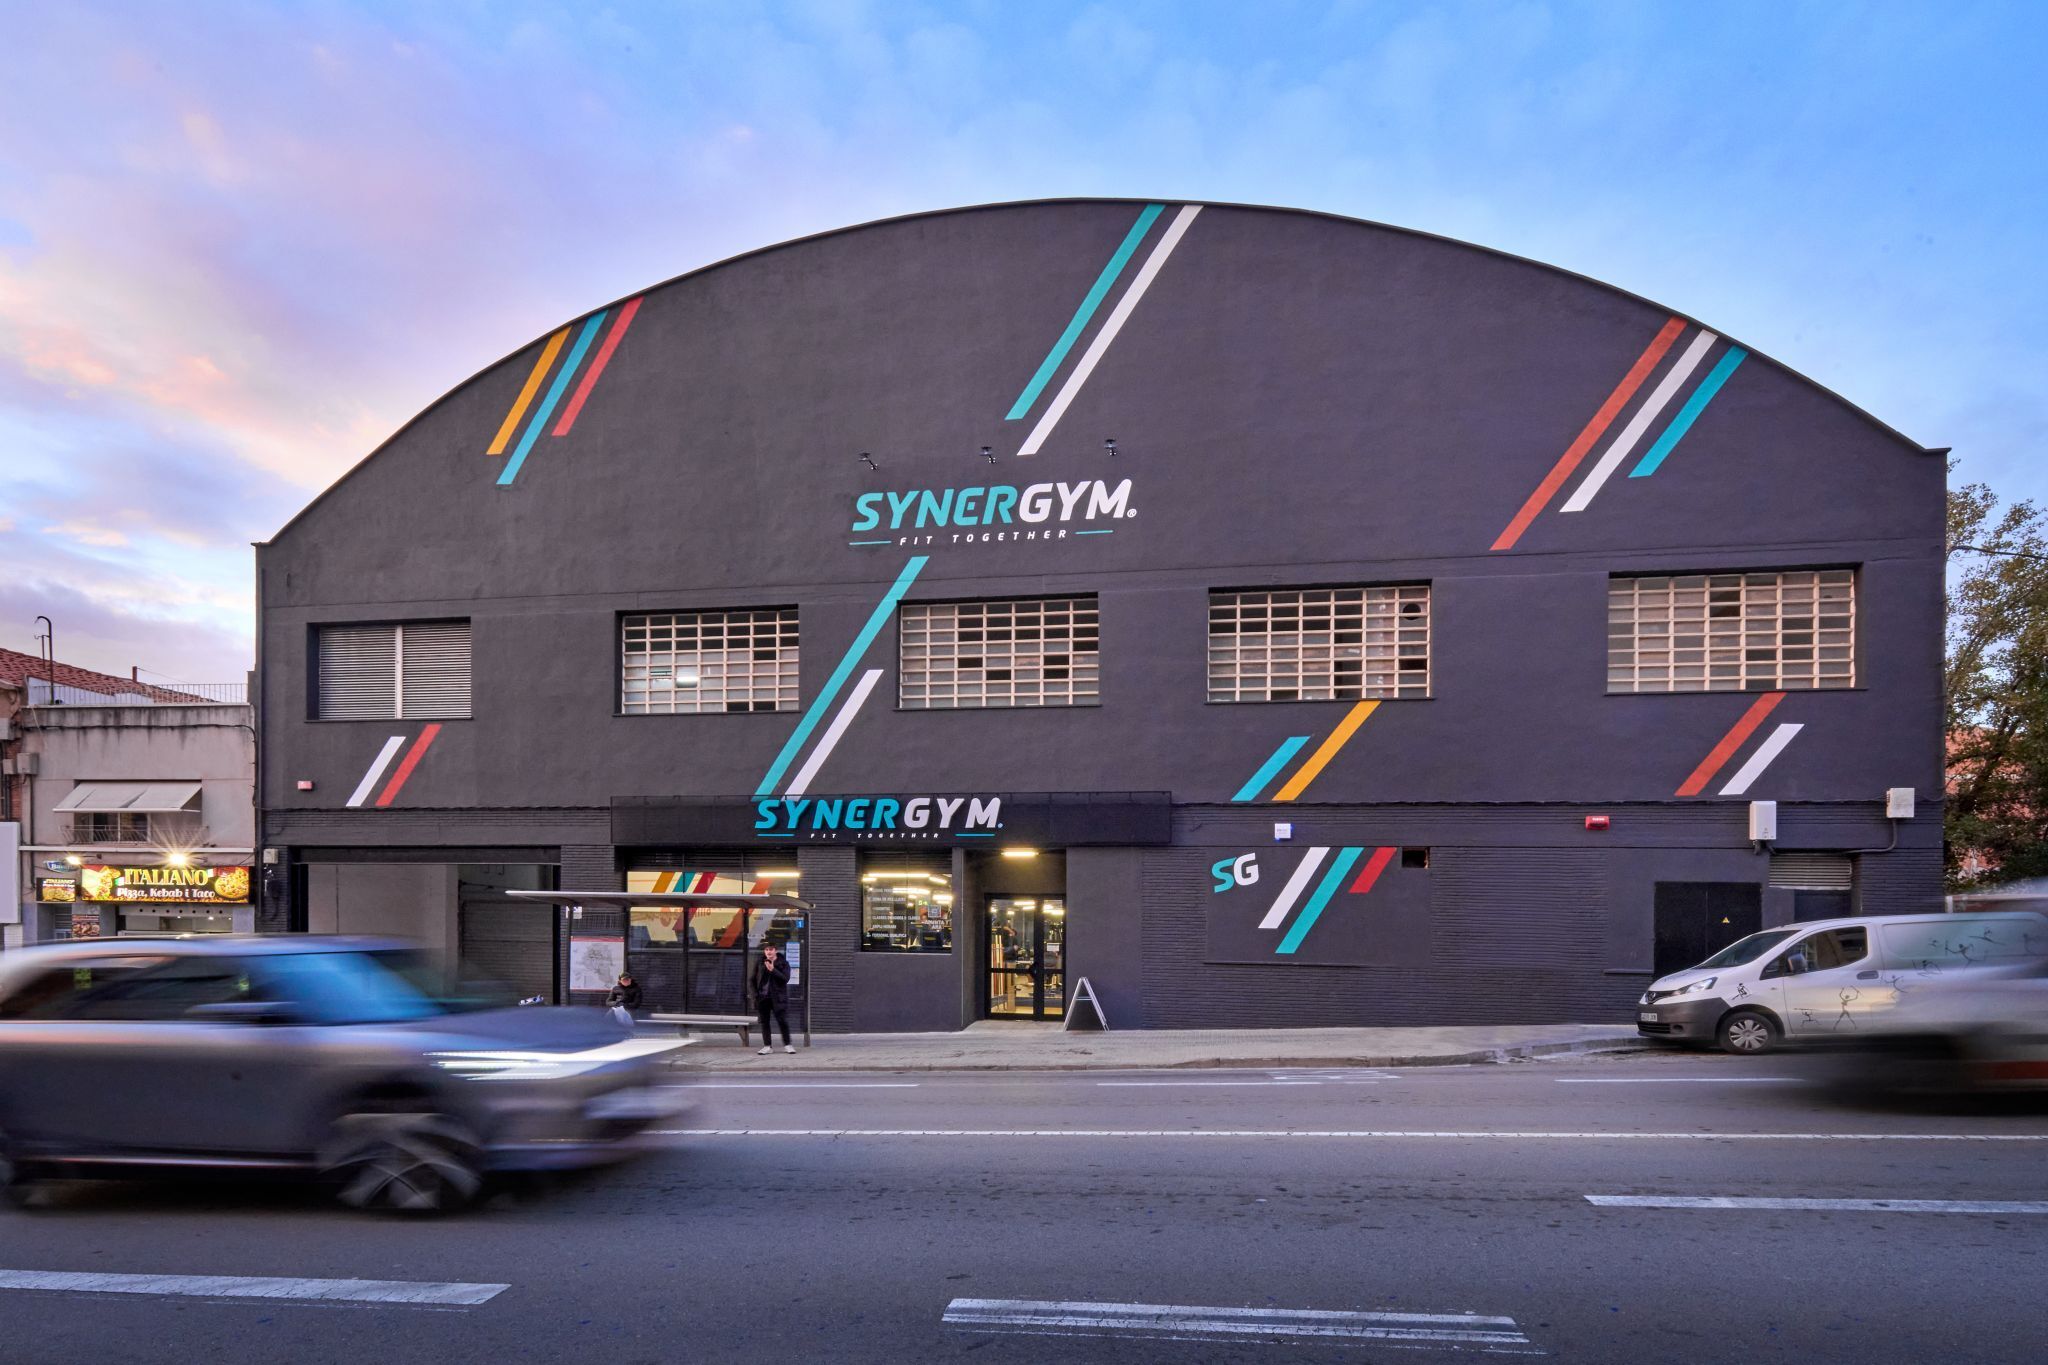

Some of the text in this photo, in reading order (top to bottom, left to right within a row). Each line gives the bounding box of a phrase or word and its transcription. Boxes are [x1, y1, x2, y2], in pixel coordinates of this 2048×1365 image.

[899, 529, 1067, 546] FIT TOGETHER
[124, 868, 209, 886] ITALIANO
[1211, 852, 1260, 893] SG
[149, 888, 183, 898] Kebab
[184, 888, 190, 898] i
[191, 889, 216, 898] Taco
